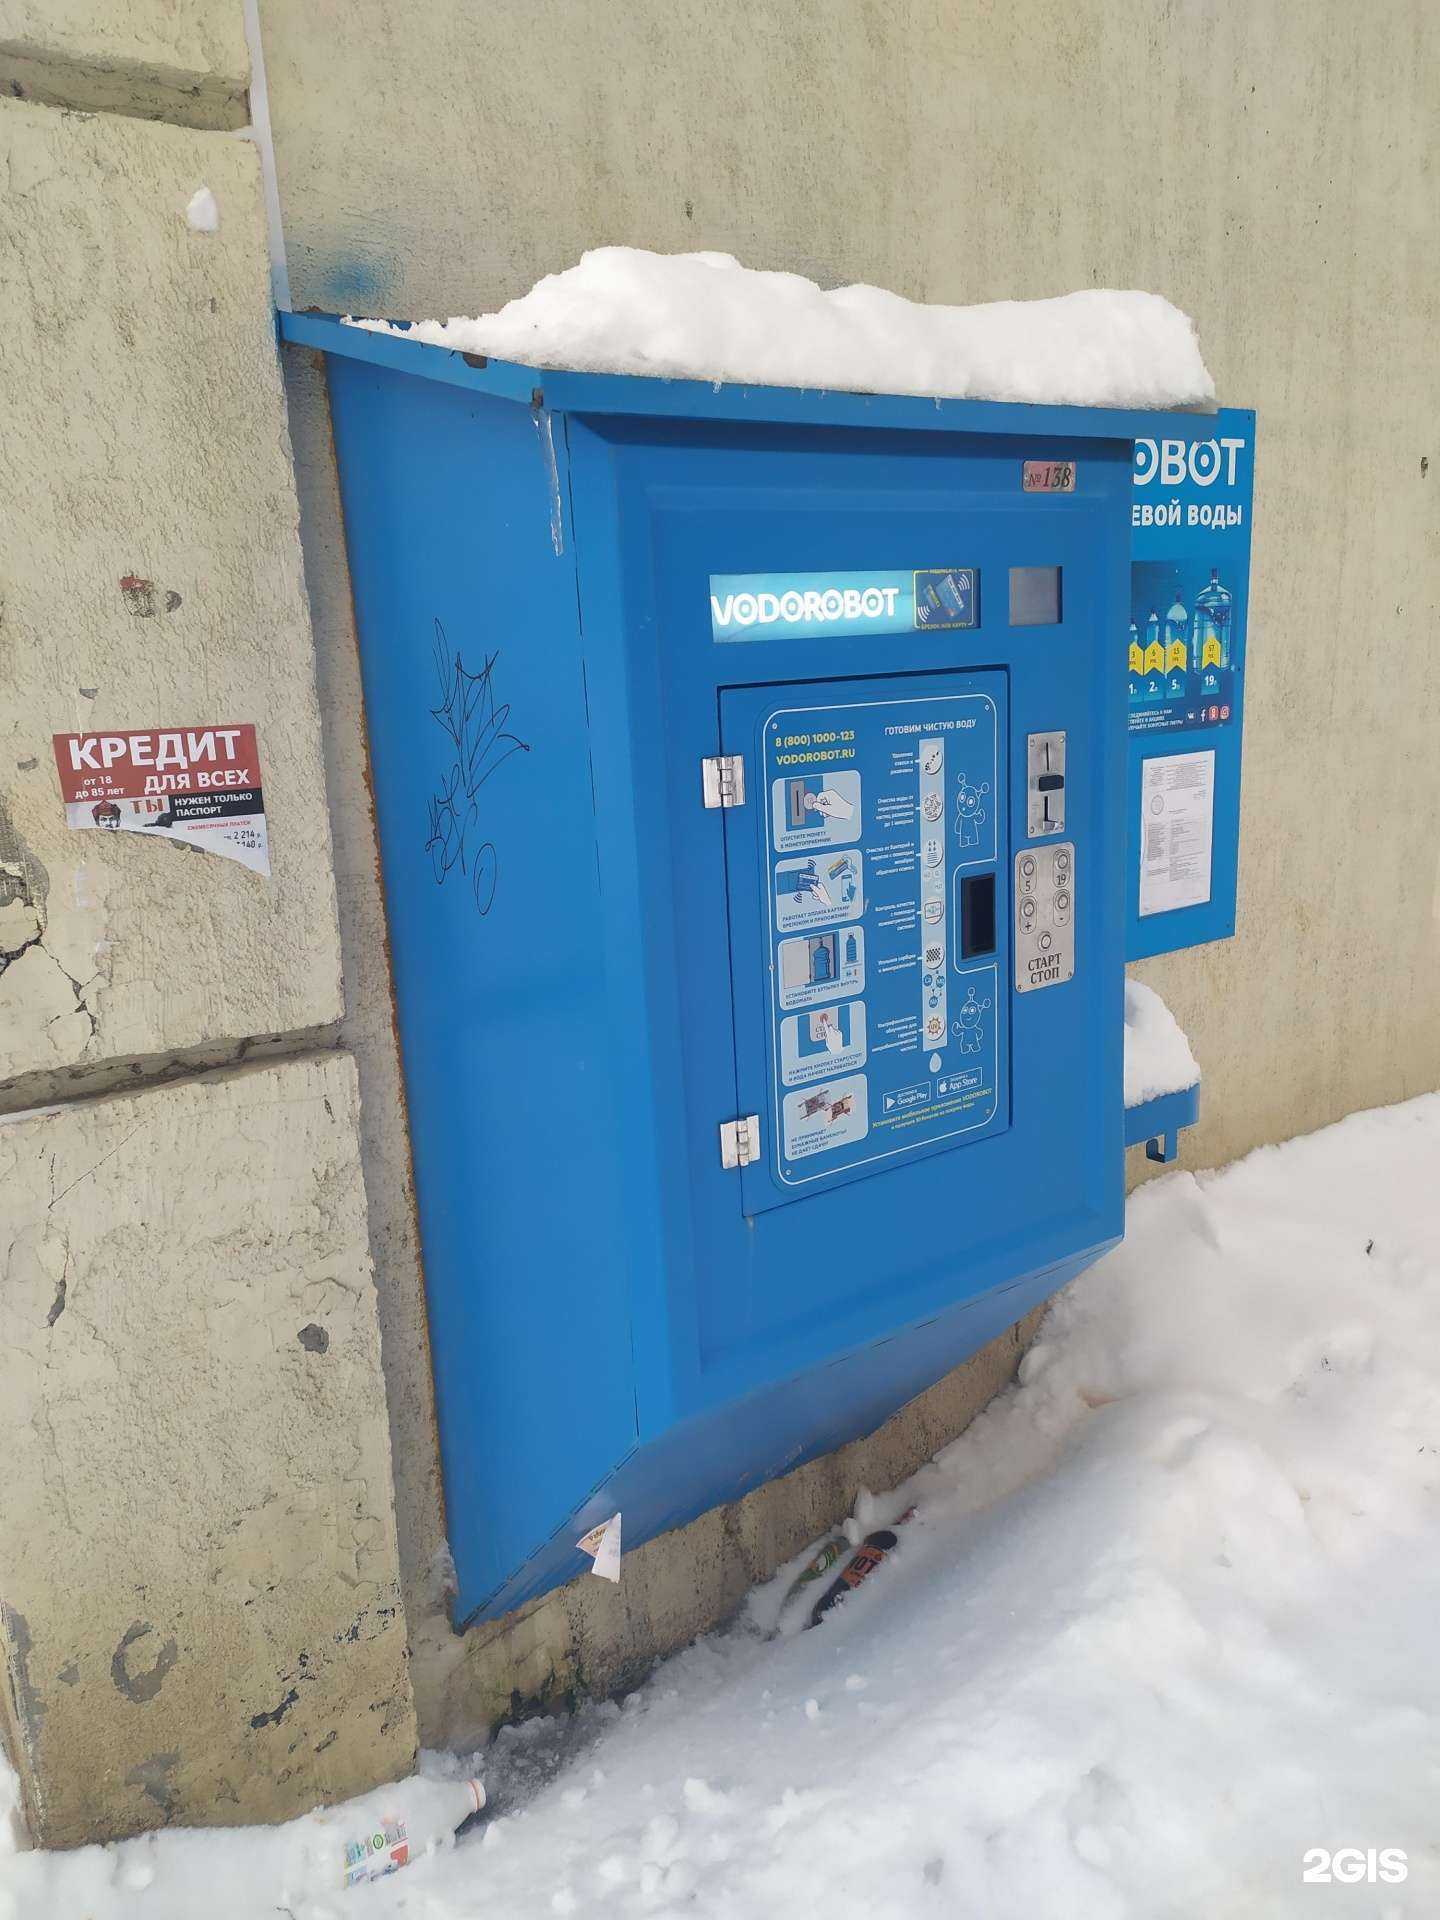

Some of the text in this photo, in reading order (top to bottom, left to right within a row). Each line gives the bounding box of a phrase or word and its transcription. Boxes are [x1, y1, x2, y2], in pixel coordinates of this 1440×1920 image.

[1132, 498, 1243, 530] ЕВОЙ ВОДЫ
[710, 588, 899, 626] VODOROBOT
[885, 719, 977, 736] ГОТОВИМ ЧИСТУЮ ВОДУ
[775, 730, 855, 749] 8 (800) 1000-123
[68, 730, 241, 771] КРЕДИТ
[776, 748, 855, 766] VODOROBOT.RU
[83, 775, 112, 786] от 18
[144, 769, 250, 795] ДЛЯ ВСЕХ
[75, 787, 124, 799] до 85 лет
[174, 793, 253, 807] НУЖЕН ТОЛЬКО
[176, 806, 222, 817] ПАСПОРТ
[1025, 880, 1031, 892] 5
[1056, 874, 1067, 886] 19
[1028, 952, 1062, 971] СТАРТ
[1030, 967, 1059, 985] СТОП
